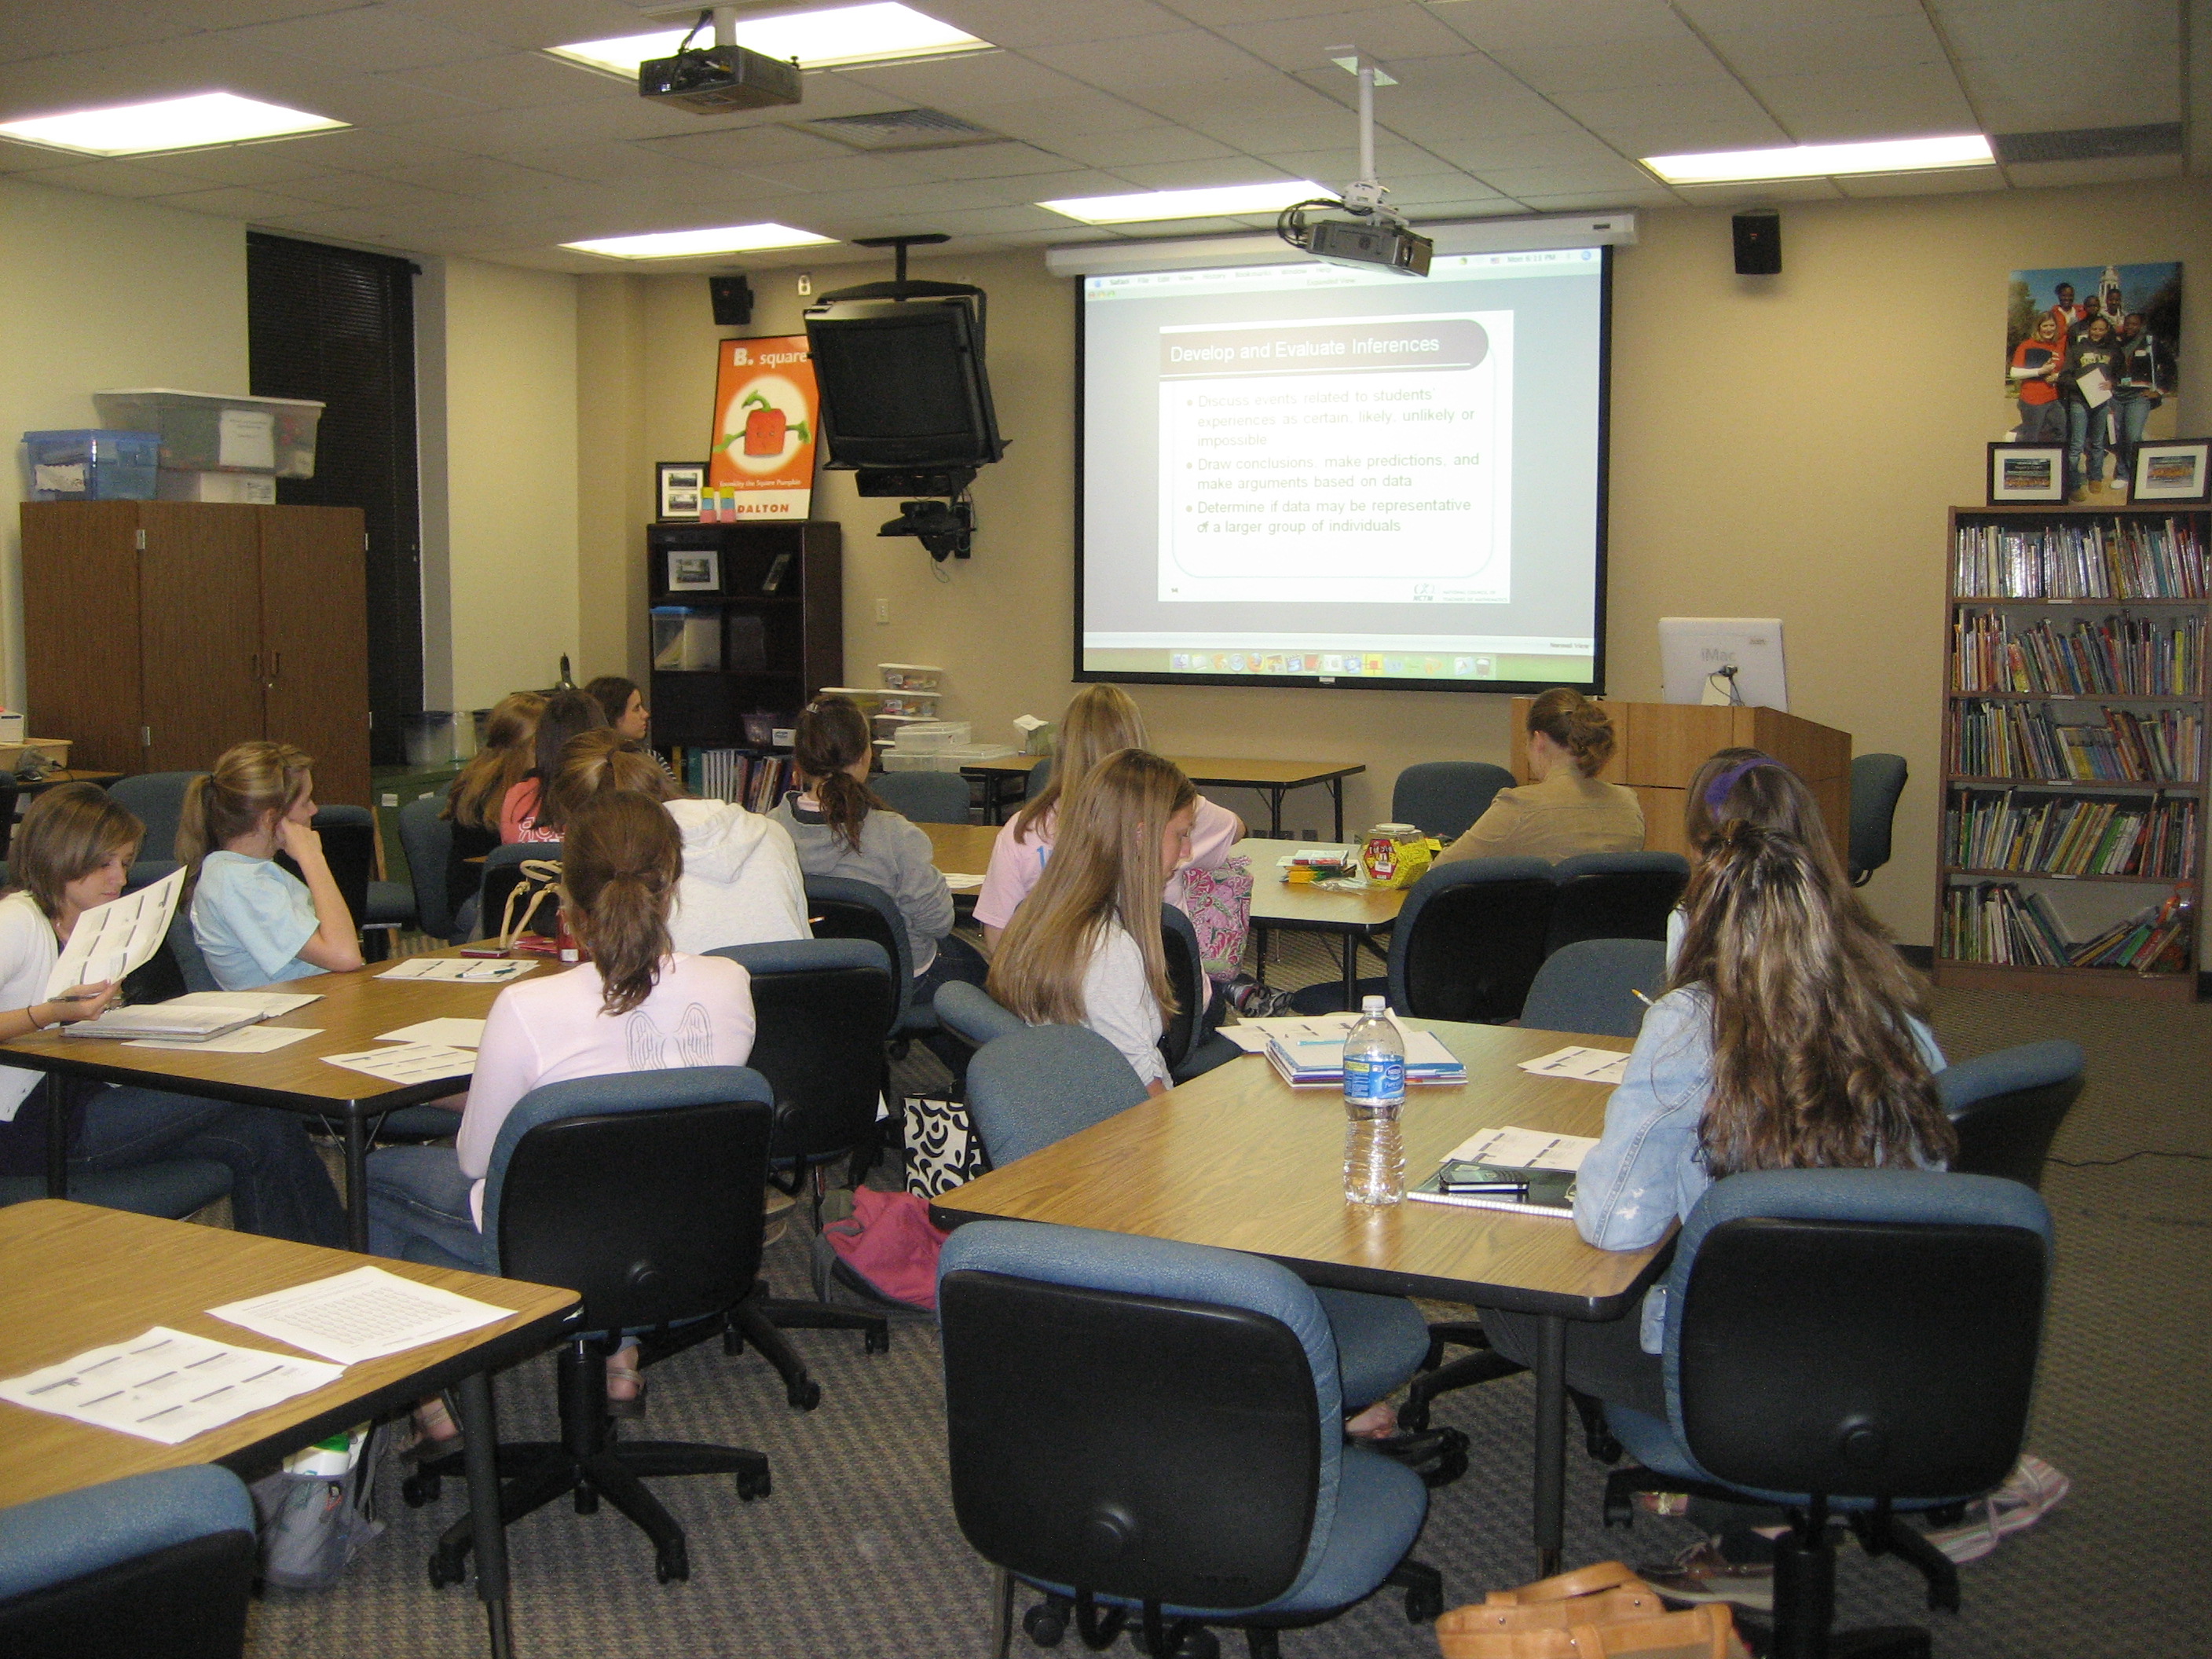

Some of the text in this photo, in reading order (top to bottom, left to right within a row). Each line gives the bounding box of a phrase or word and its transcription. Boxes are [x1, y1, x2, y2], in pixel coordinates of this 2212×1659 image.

[734, 347, 808, 368] B. square
[1170, 336, 1441, 364] Develop and Evaluate Inferences
[1198, 388, 1436, 408] Discuss events related to students'
[1197, 408, 1475, 429] experiences as certain, likely, unlikely or
[1197, 434, 1268, 449] impossible
[1198, 453, 1480, 471] Draw conclusions, make predictions, and
[1197, 474, 1412, 492] make arguments based on data
[737, 504, 789, 513] DALTON
[1198, 498, 1472, 515] Determine if data may be representative
[1197, 518, 1401, 536] of a larger group of individuals
[1701, 647, 1736, 661] iMac
